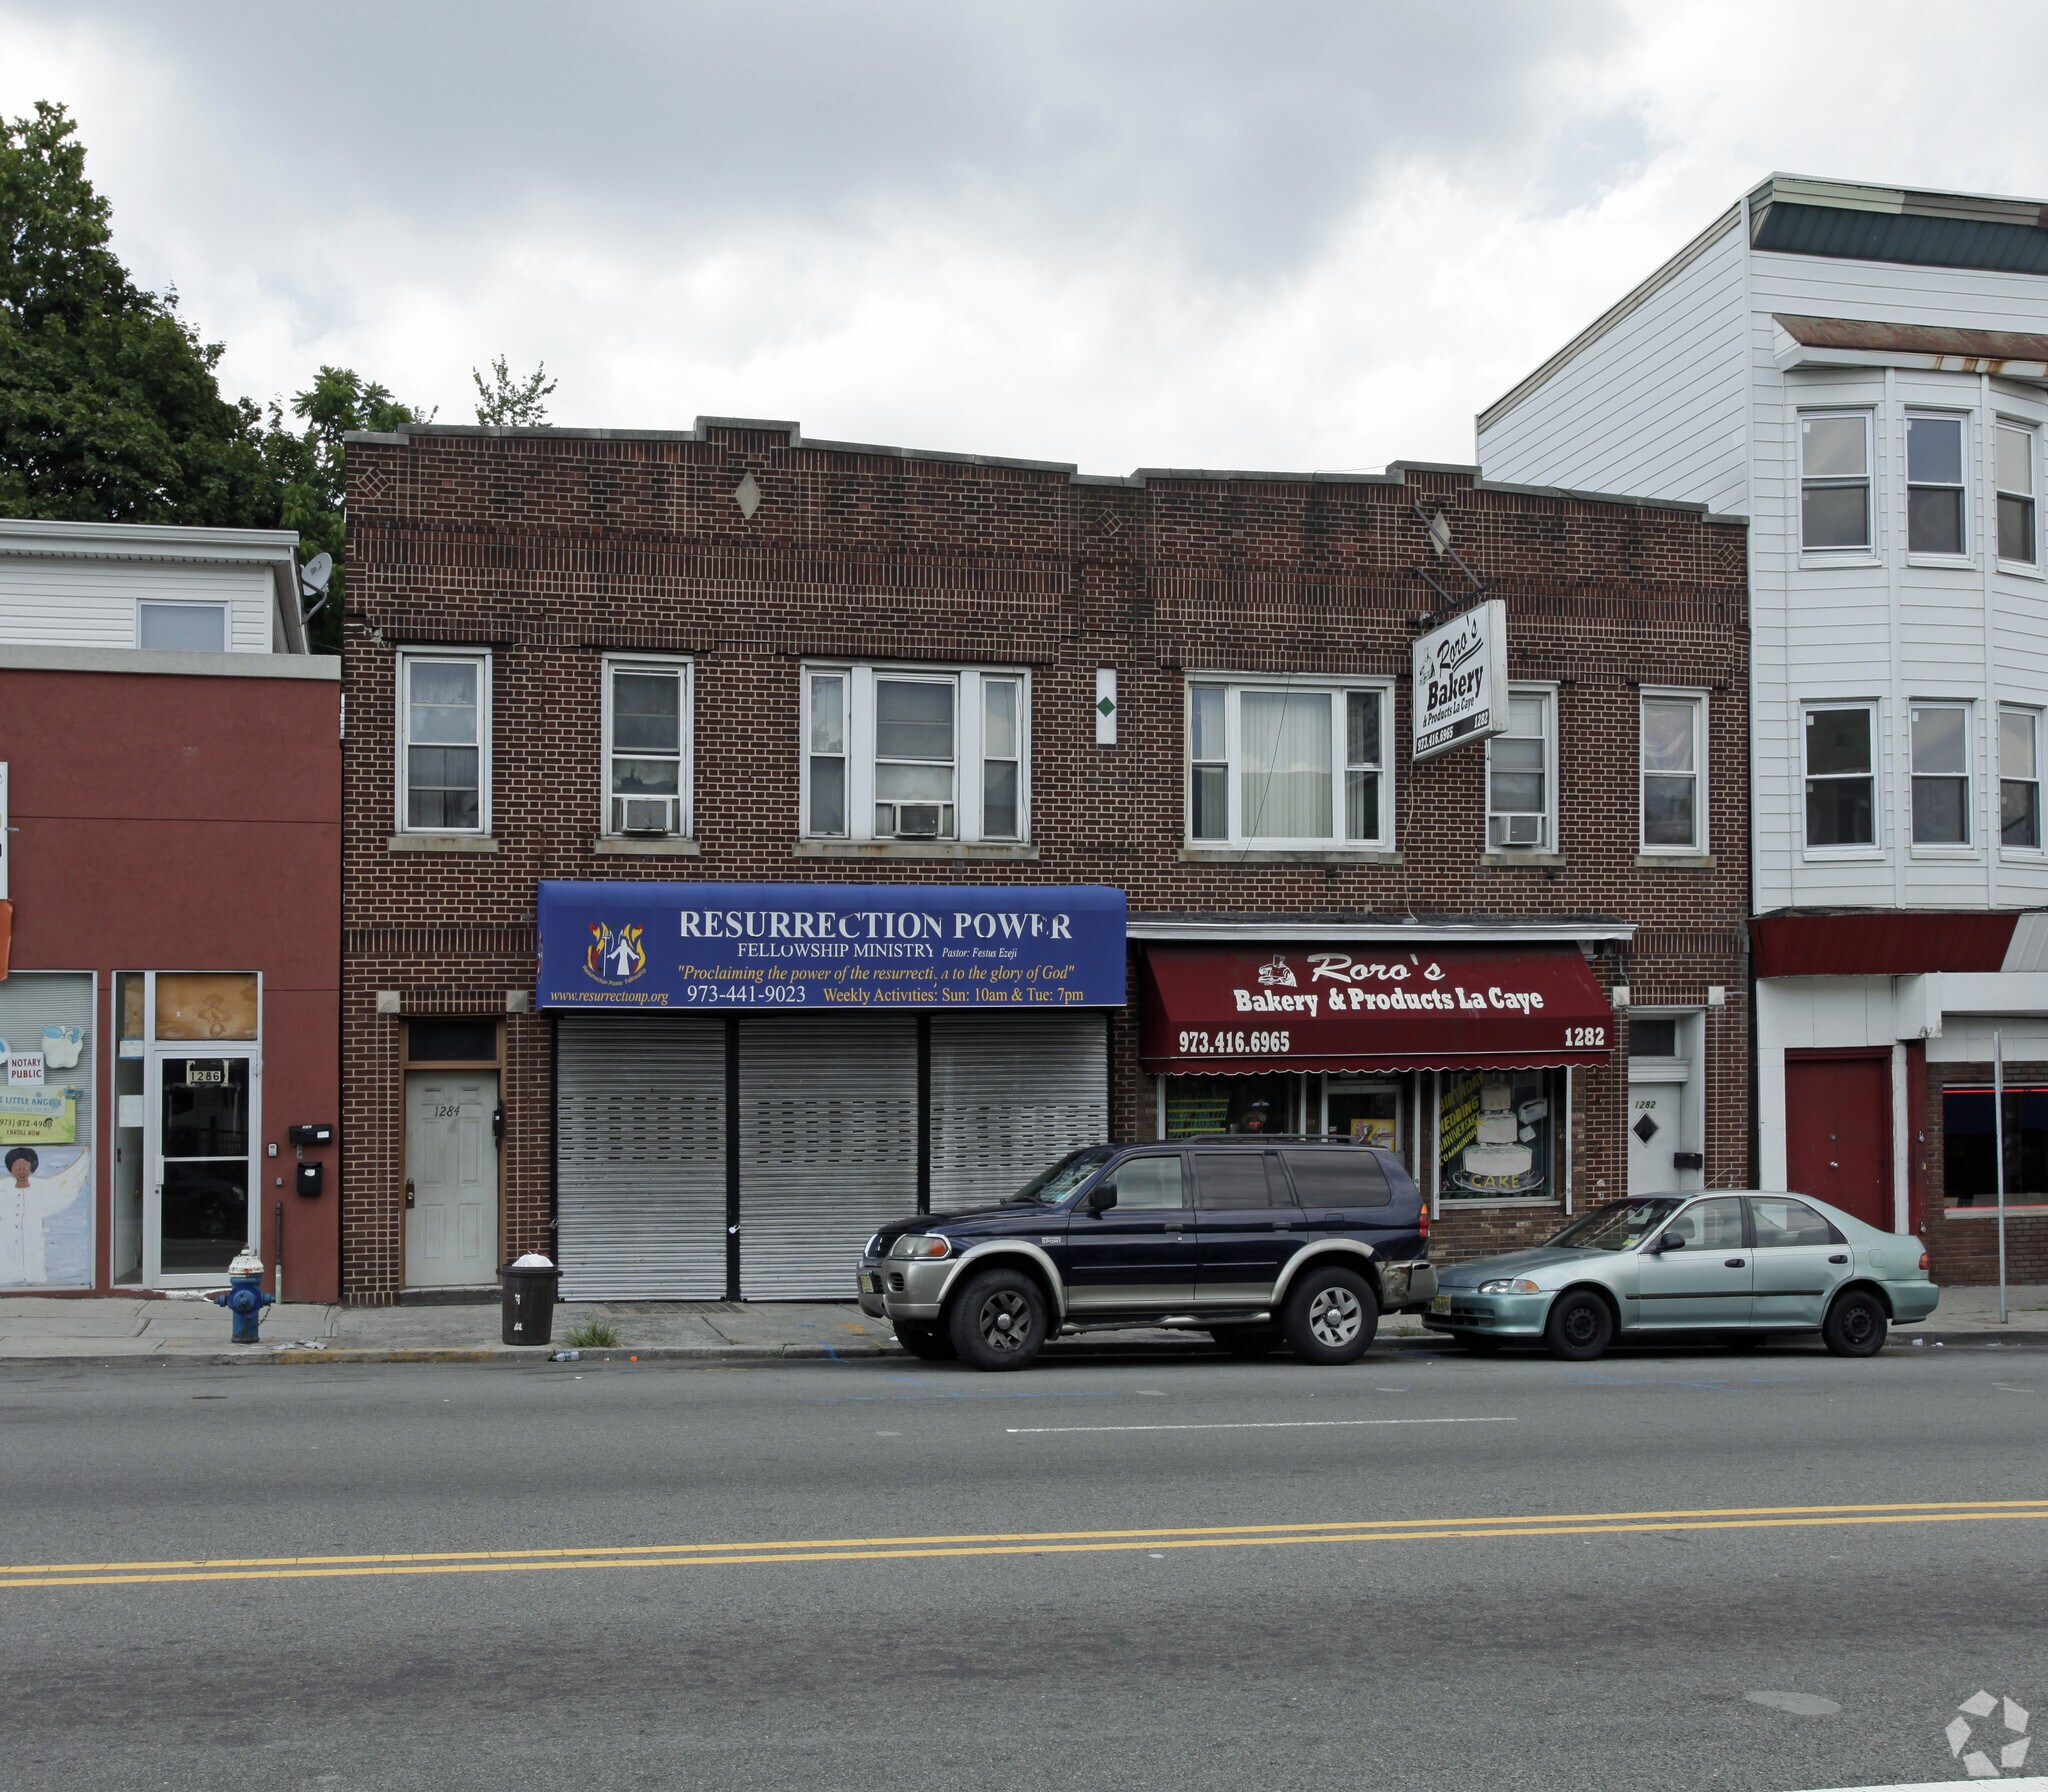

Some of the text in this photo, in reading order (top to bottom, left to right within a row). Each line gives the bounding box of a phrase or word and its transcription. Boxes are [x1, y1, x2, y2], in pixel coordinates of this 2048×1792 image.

[1437, 615, 1479, 678] Roro's
[1427, 666, 1483, 711] Bakery
[1423, 697, 1474, 727] & Products La Caye
[1474, 711, 1488, 728] 1282
[1417, 726, 1453, 751] 973.416.6965
[680, 910, 943, 939] RESURRECTION
[738, 943, 1017, 960] FELLOWSHIP MINISTRY Pastor: Festus Ezeji
[678, 965, 1075, 983] "Proclaiming the power of the resurrectin to the glory of God"
[1307, 952, 1446, 983] Roro's
[551, 990, 669, 1005] www.resurrectionp.org
[687, 985, 806, 1002] 973-441-9023
[824, 987, 1084, 1005] Weekly Activities: Sun: 10am & Tue: 7pm
[1233, 986, 1544, 1017] Bakery & Products La Caye
[1179, 1031, 1290, 1054] 973.416.6965
[1565, 1026, 1605, 1046] 1282
[12, 1058, 41, 1067] NOTARY
[12, 1069, 42, 1078] PUBLIC
[190, 1071, 220, 1081] 1286
[6, 1096, 29, 1105] LITTLE
[1635, 1101, 1657, 1110] 1282
[434, 1105, 460, 1117] 1284
[1440, 1127, 1477, 1166] COMMUNION
[1472, 1174, 1520, 1189] CAKE
